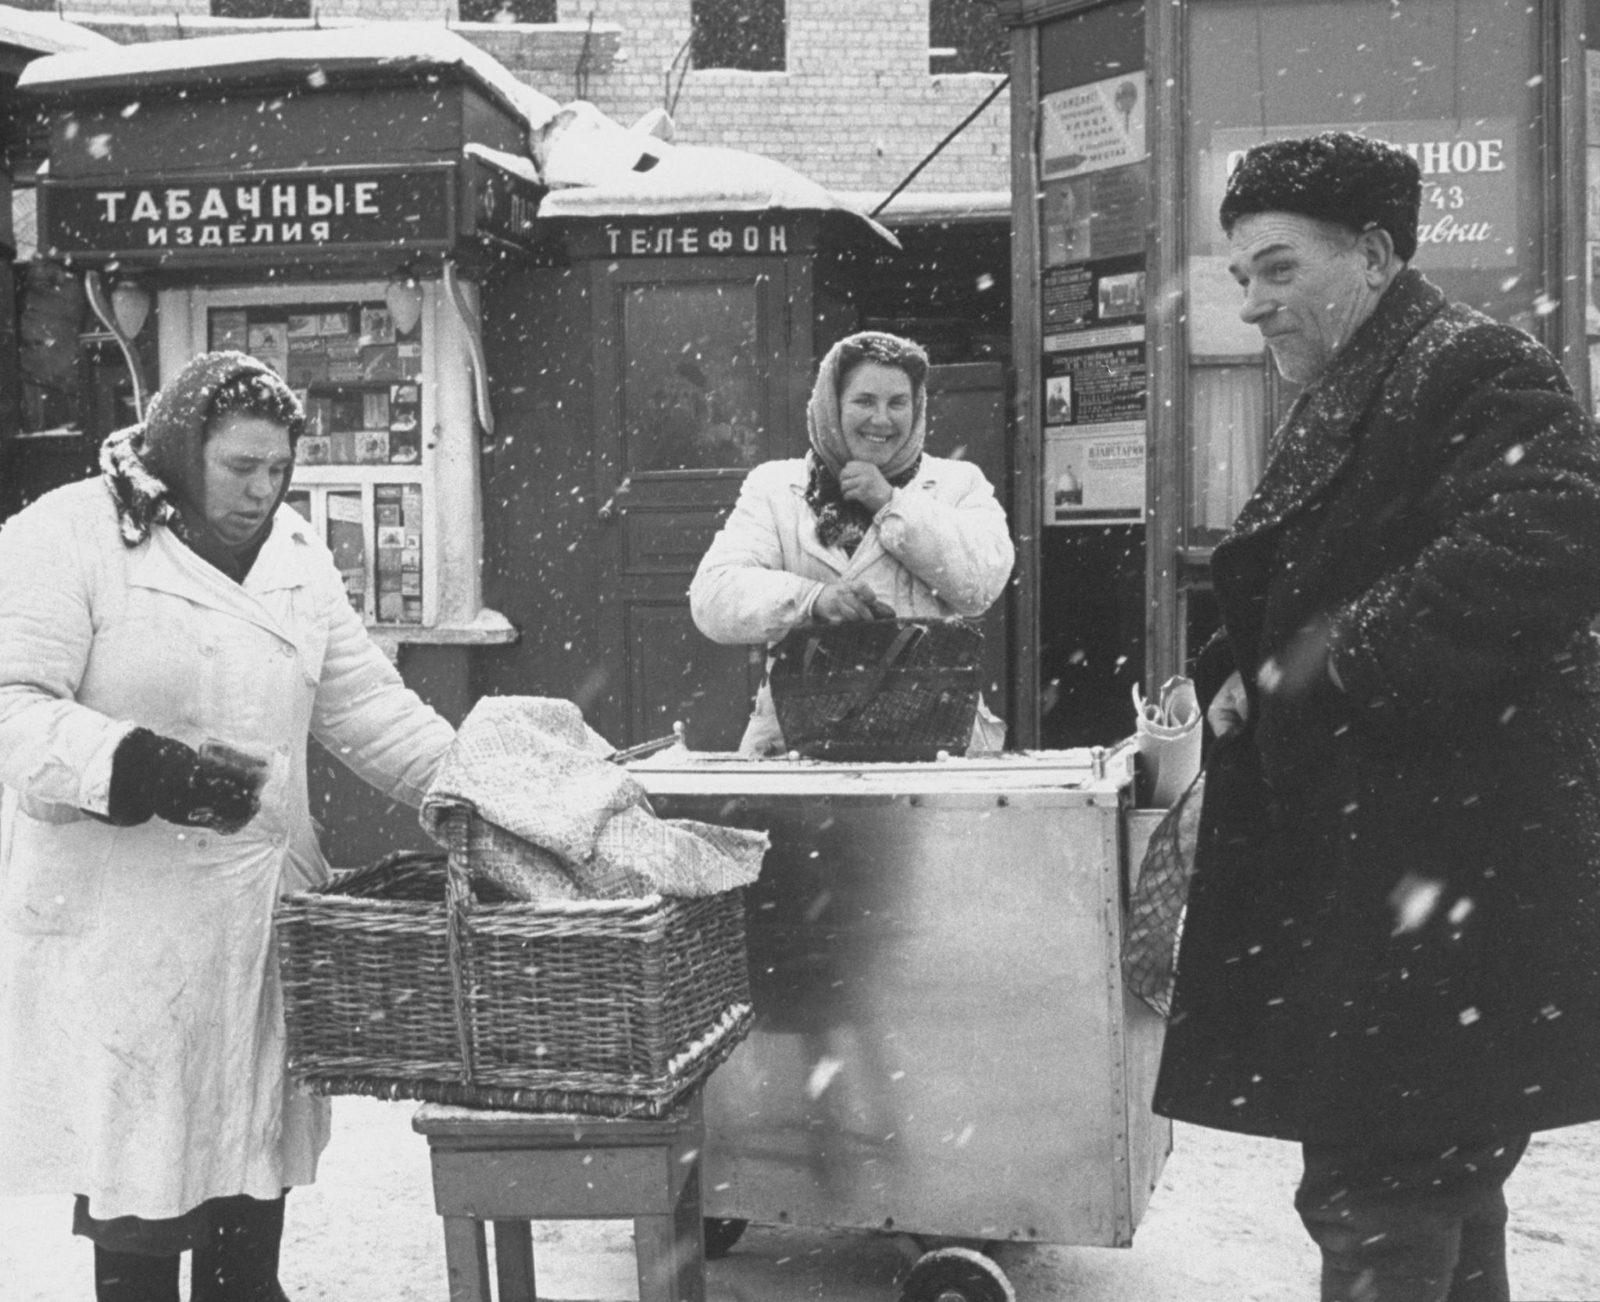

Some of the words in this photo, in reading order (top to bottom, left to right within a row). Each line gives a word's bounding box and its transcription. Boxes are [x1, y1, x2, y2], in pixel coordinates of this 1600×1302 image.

[97, 182, 379, 222] ТАБАЧНЫЕ
[1430, 186, 1464, 209] 43
[148, 221, 330, 246] ИЗДЕЛИЯ
[607, 225, 787, 254] ТЕЛЕФОН
[1417, 214, 1493, 243] авки
